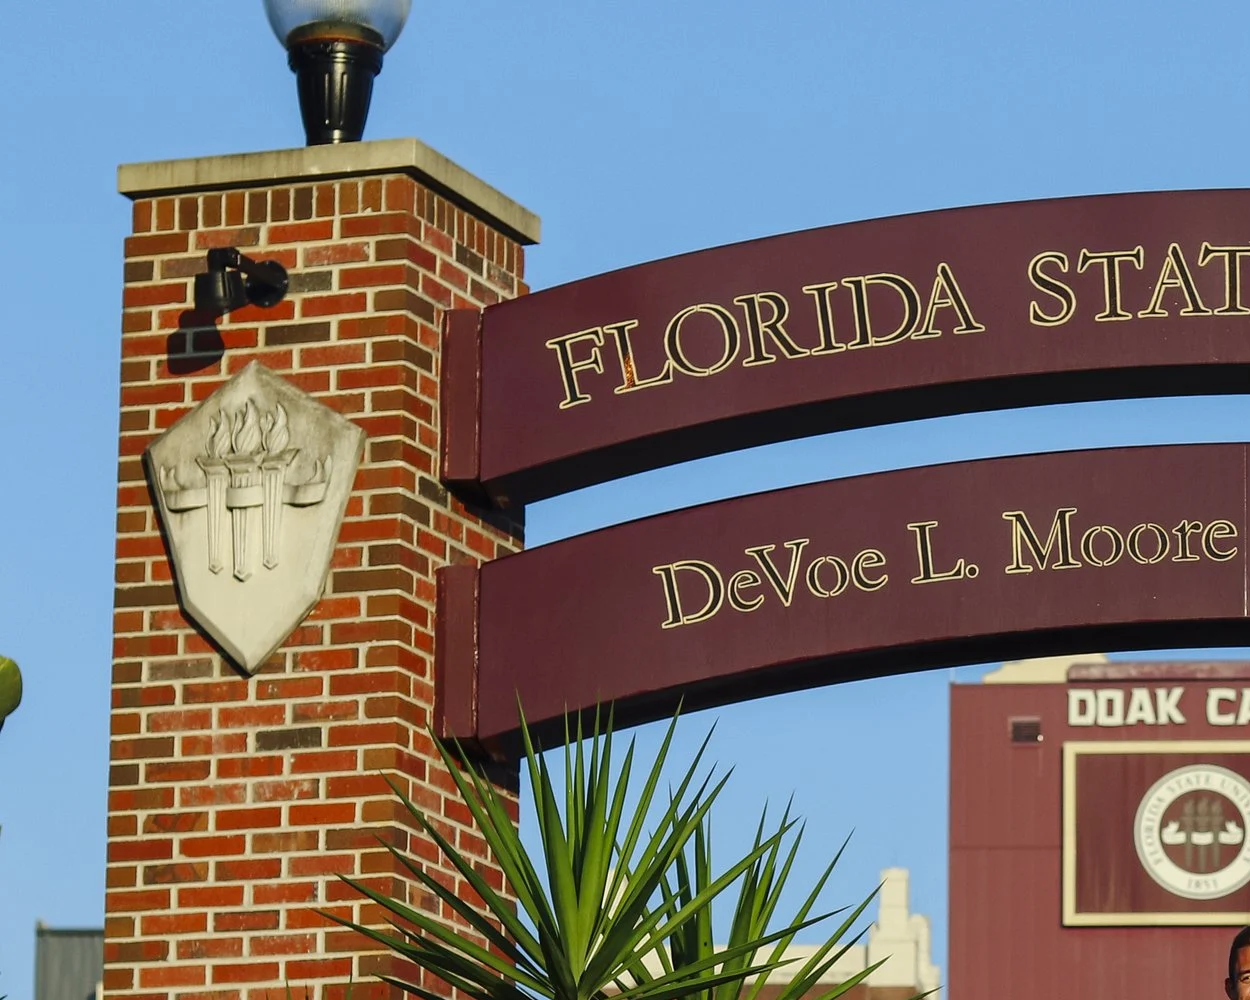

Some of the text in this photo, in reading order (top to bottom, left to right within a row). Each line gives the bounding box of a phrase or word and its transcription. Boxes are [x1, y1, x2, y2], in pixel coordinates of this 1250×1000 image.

[546, 262, 985, 410] FLORIDA
[653, 538, 888, 628] DeVoe
[908, 520, 979, 585] L.
[1003, 507, 1239, 574] Moore
[1067, 687, 1185, 727] DOAK
